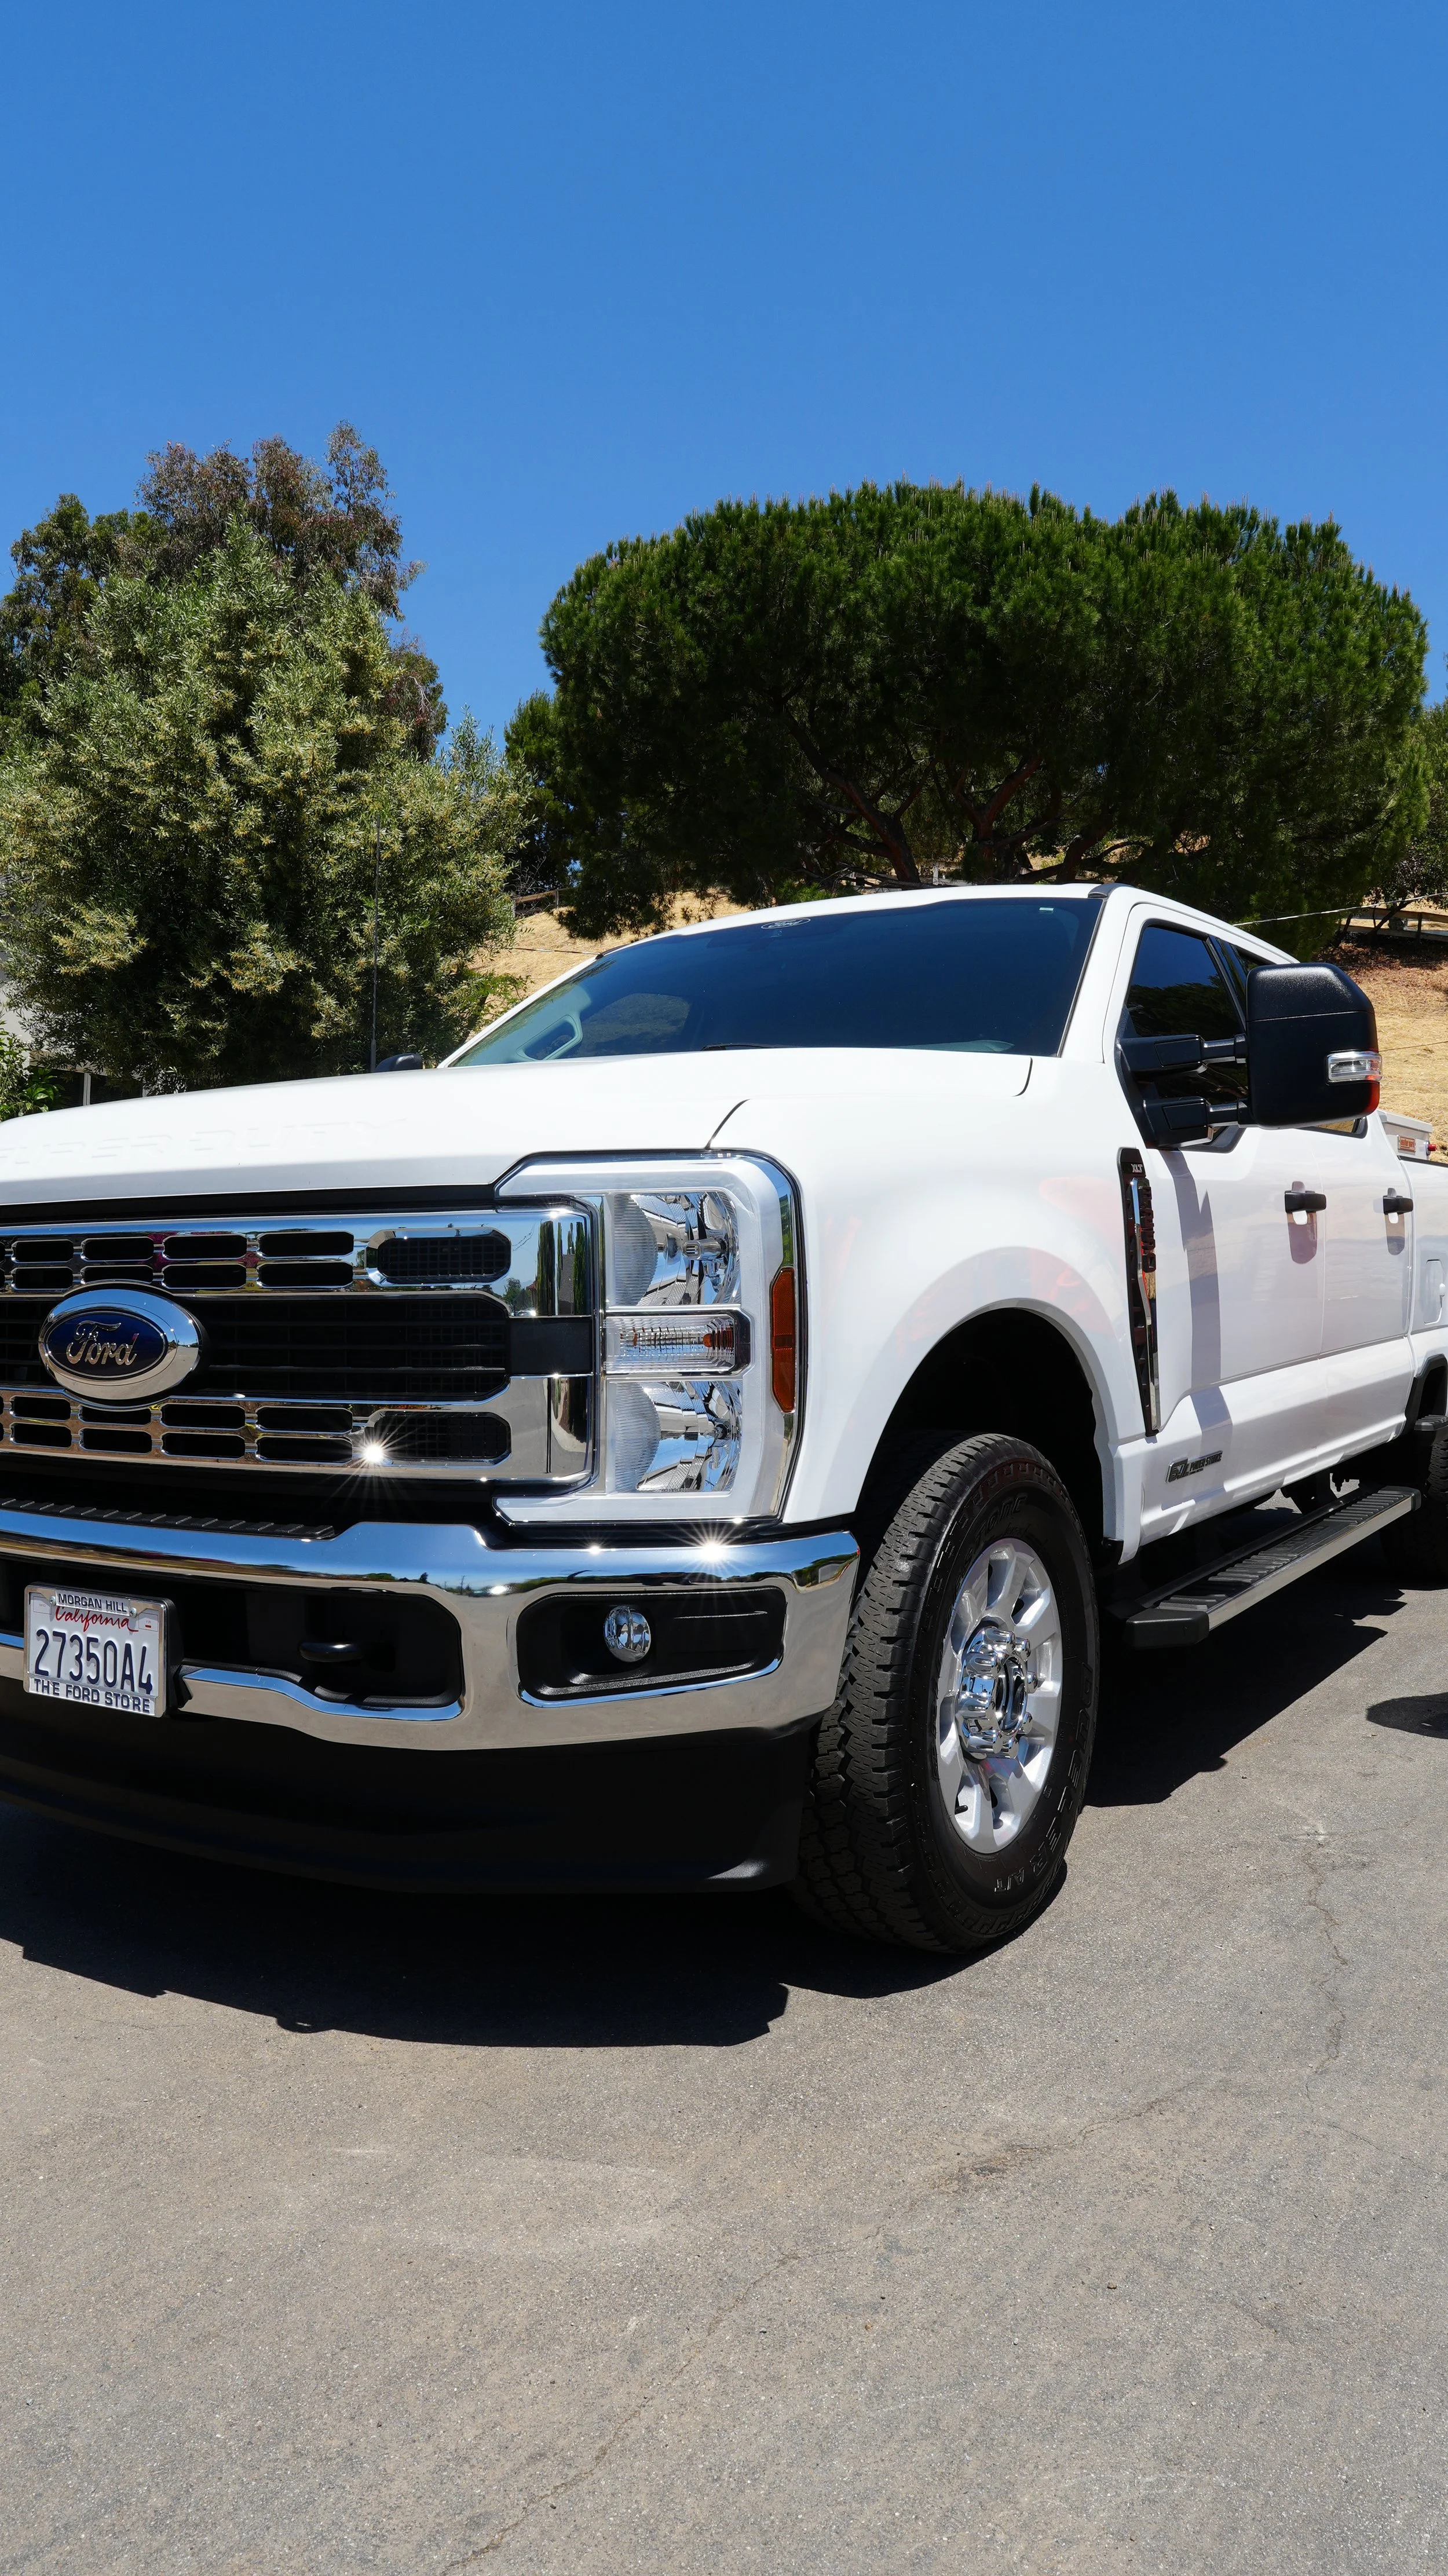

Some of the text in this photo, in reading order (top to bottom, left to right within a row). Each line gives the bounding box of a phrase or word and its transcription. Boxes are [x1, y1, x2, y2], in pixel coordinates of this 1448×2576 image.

[768, 919, 803, 928] Ford
[181, 1117, 407, 1156] DUTY
[1131, 1163, 1143, 1173] XLT
[65, 1320, 140, 1366] Ford
[58, 1593, 127, 1613] MORGAN HILL
[55, 1606, 139, 1633] California
[35, 1629, 153, 1695] 27350A4
[34, 1678, 151, 1714] THE FORD STORE
